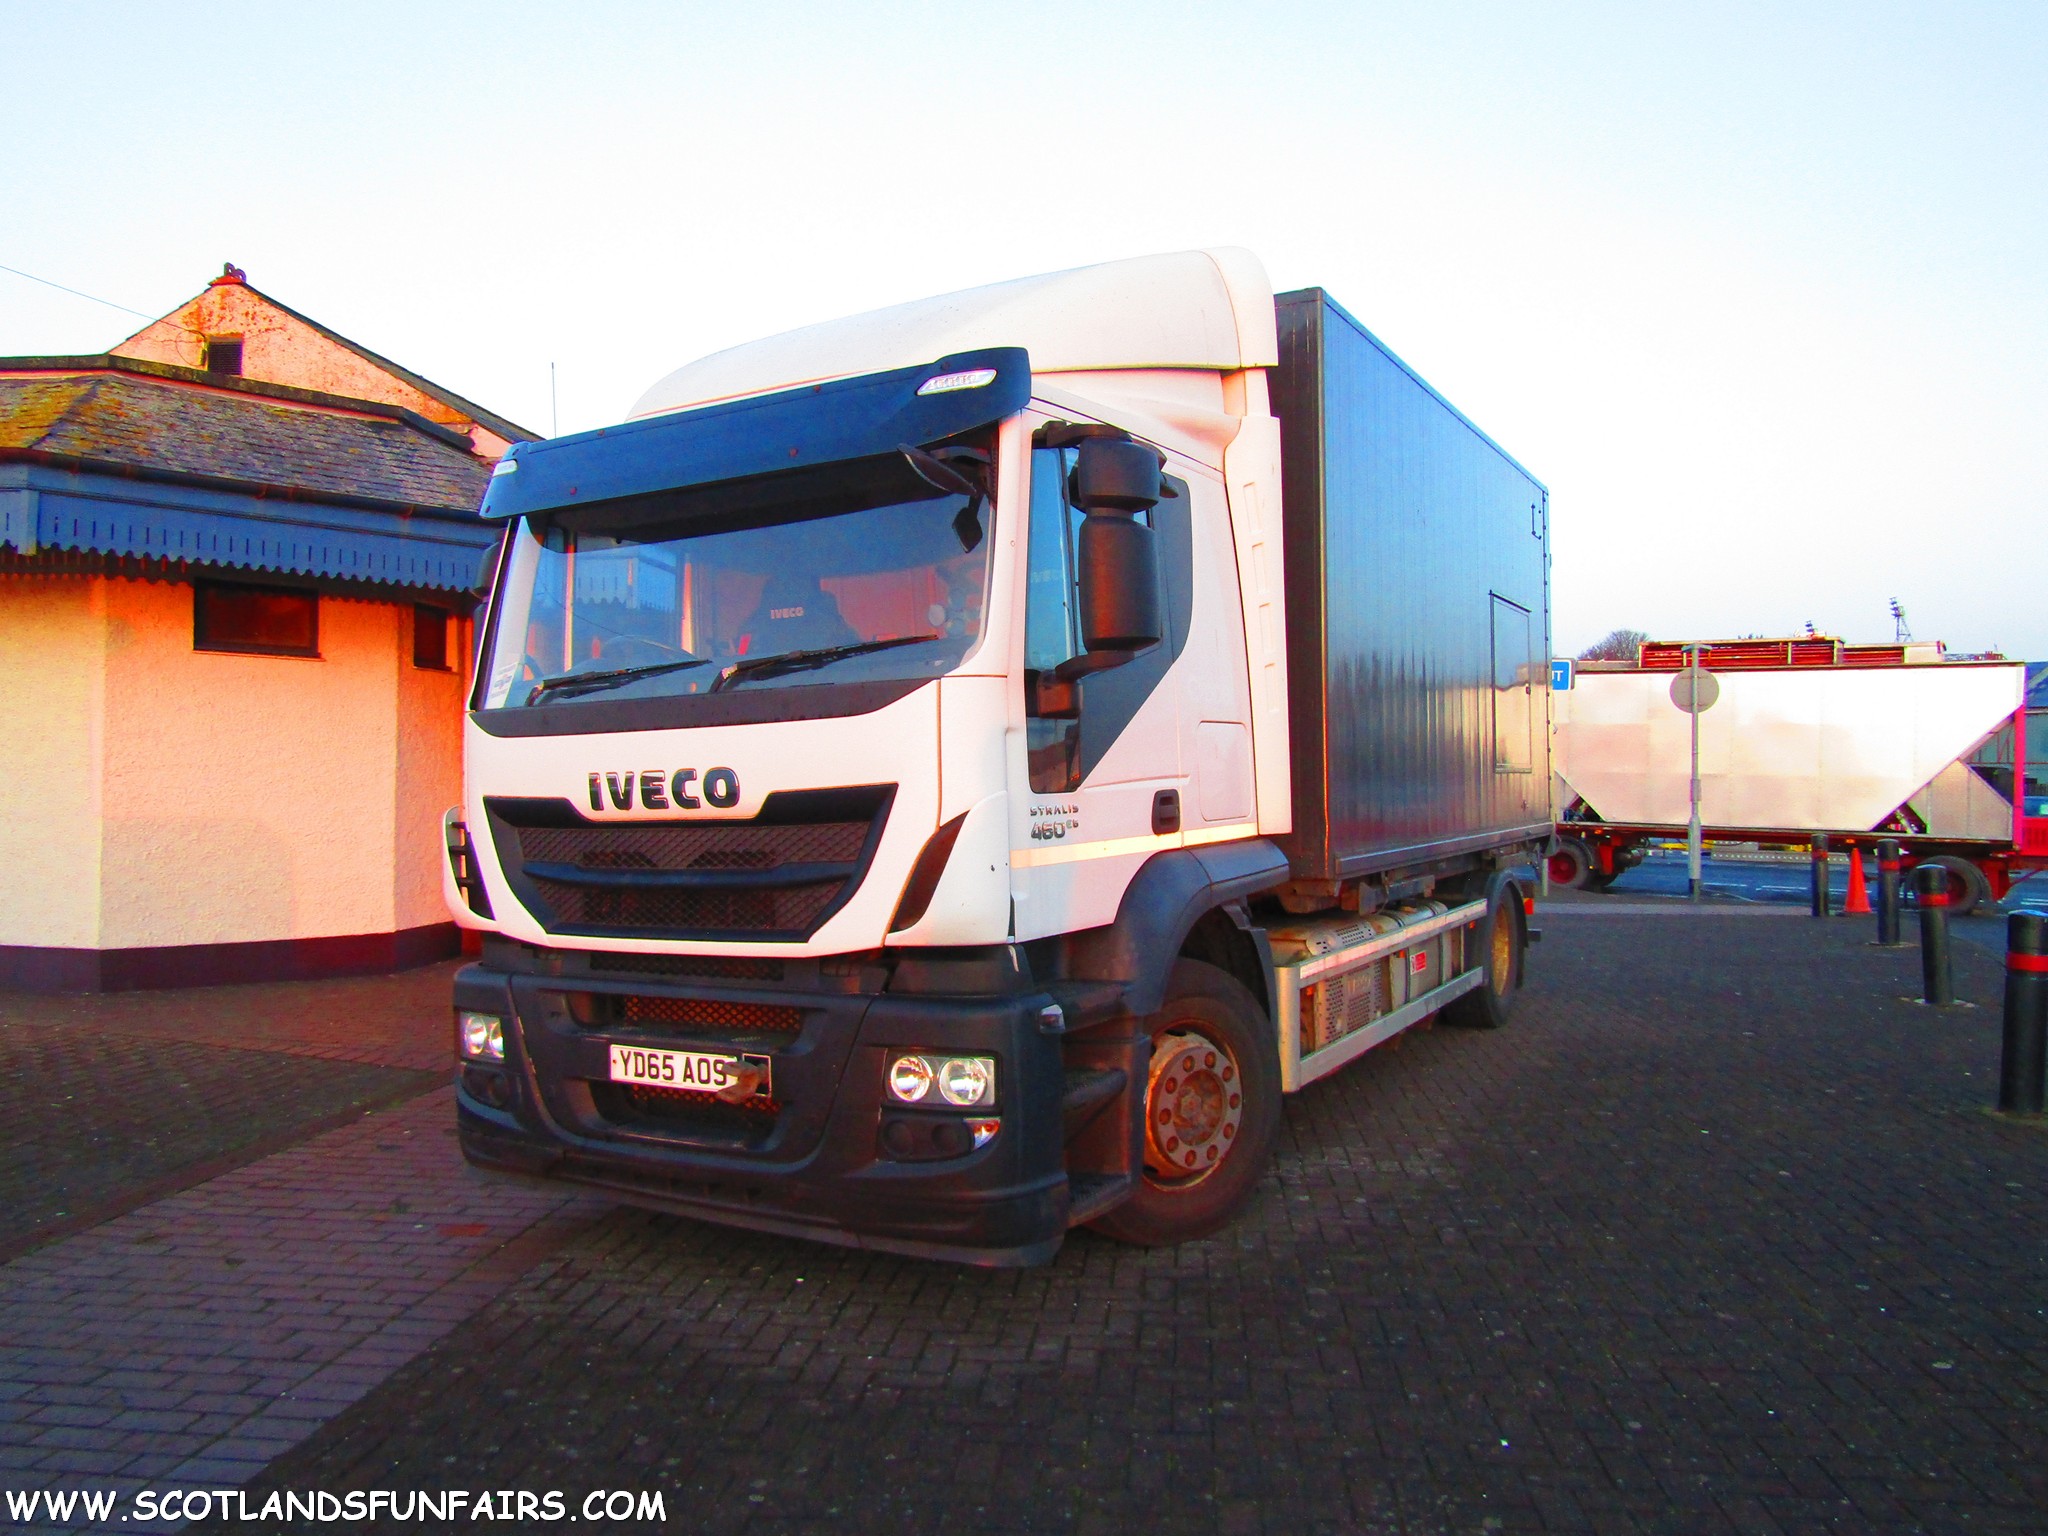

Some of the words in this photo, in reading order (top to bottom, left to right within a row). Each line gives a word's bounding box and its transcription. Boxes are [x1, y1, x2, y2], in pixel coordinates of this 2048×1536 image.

[587, 766, 740, 811] IVECO
[1030, 804, 1079, 816] STRALIS
[619, 1049, 674, 1081] YD65
[682, 1056, 727, 1087] AOS
